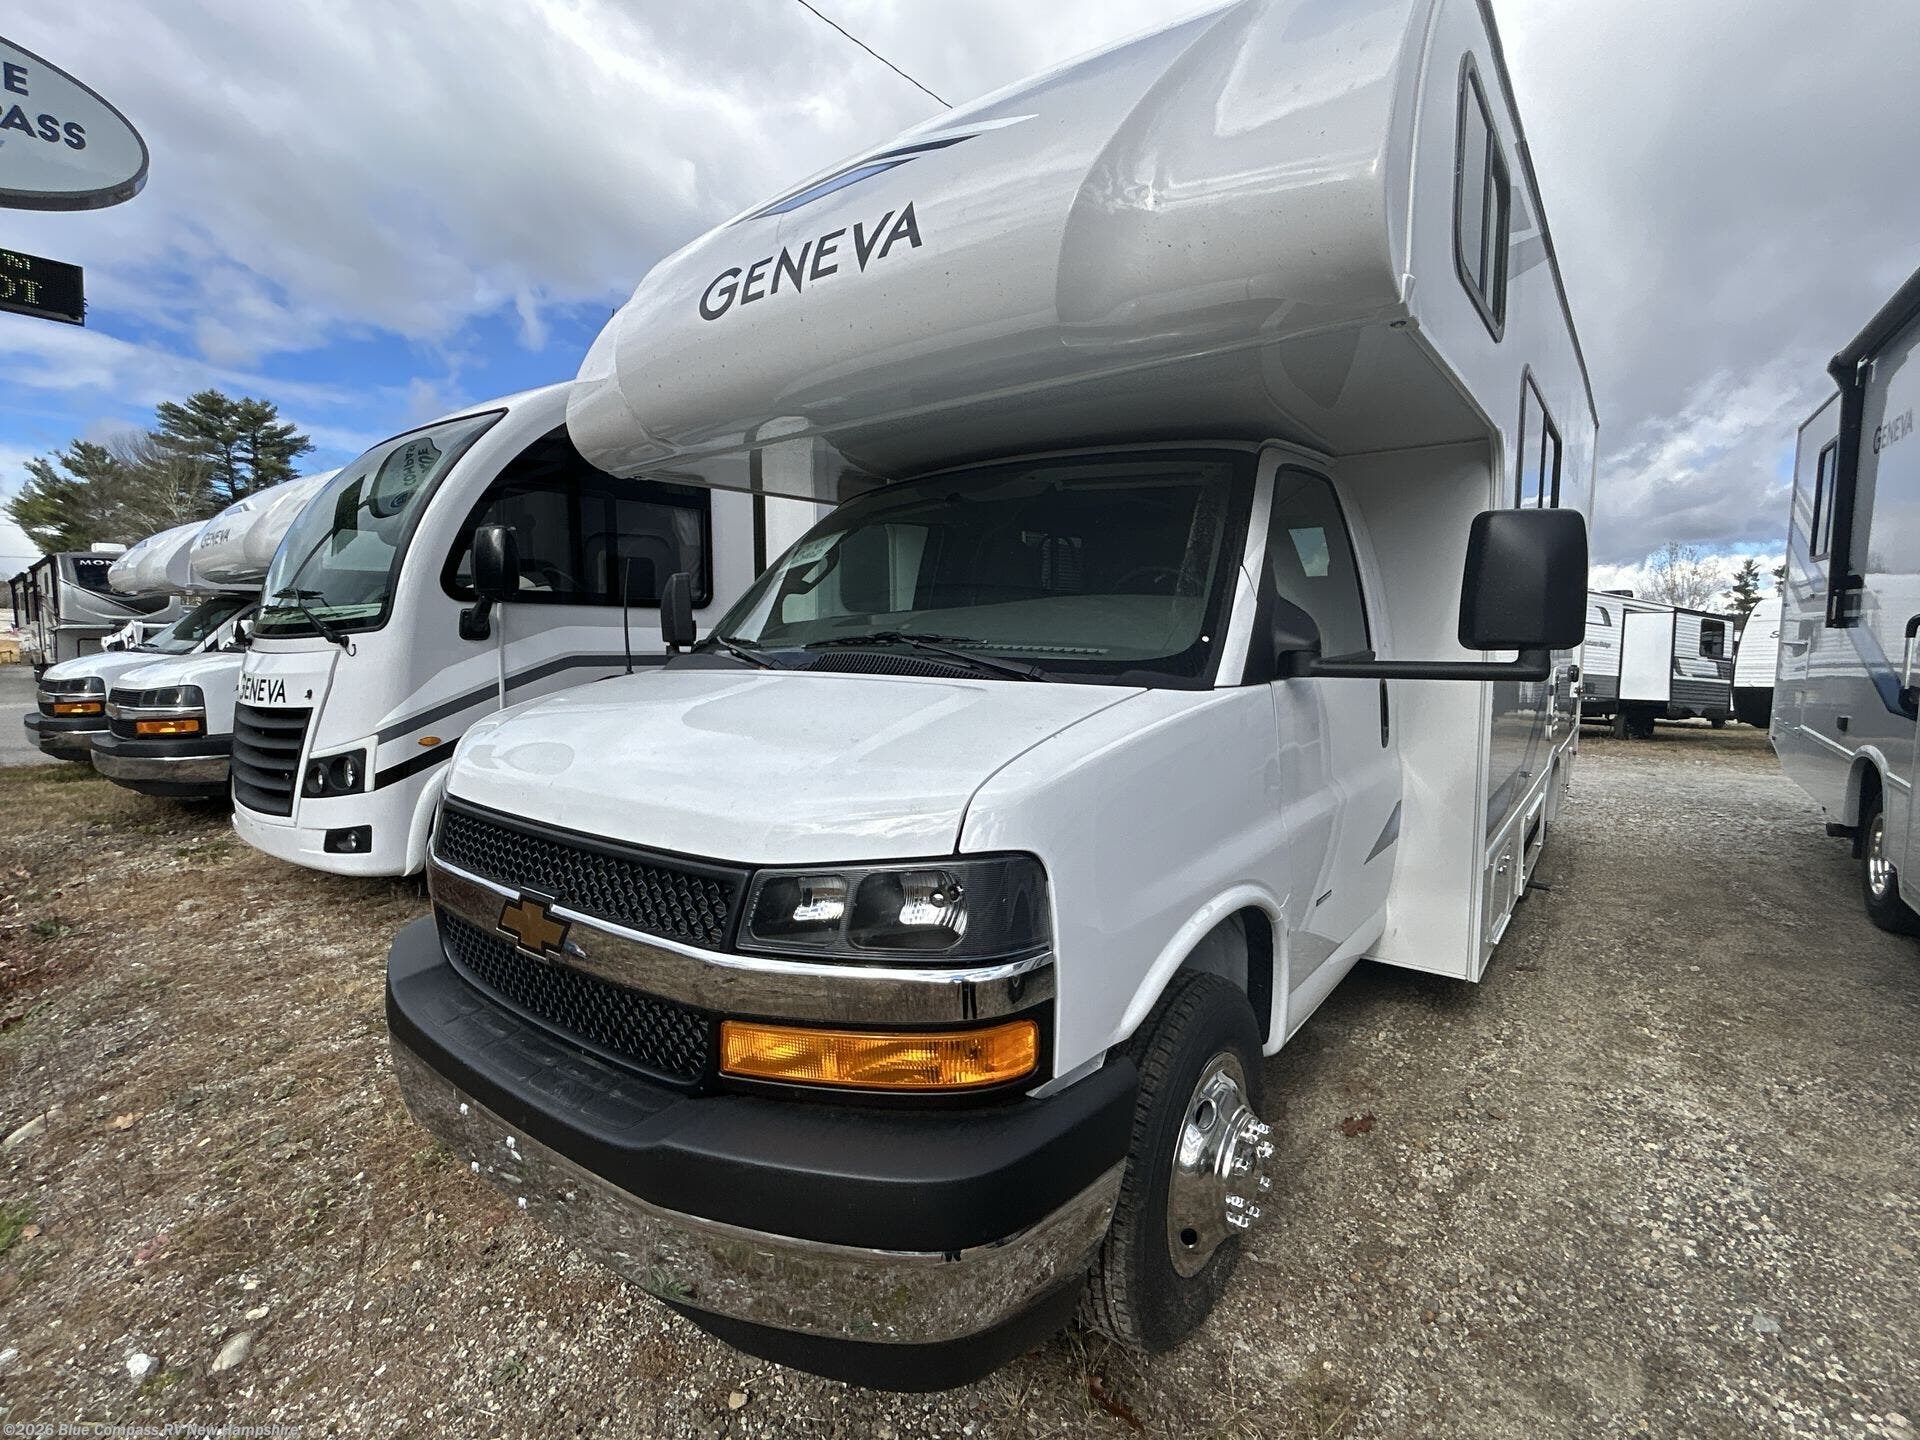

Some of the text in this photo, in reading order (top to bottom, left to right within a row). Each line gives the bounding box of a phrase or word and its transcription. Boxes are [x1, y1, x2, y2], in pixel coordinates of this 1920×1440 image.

[0, 104, 86, 150] ASS
[699, 201, 922, 321] GENEVA
[1873, 407, 1913, 455] GENEVA
[201, 528, 231, 549] GENEVA
[239, 673, 287, 704] GENEVA
